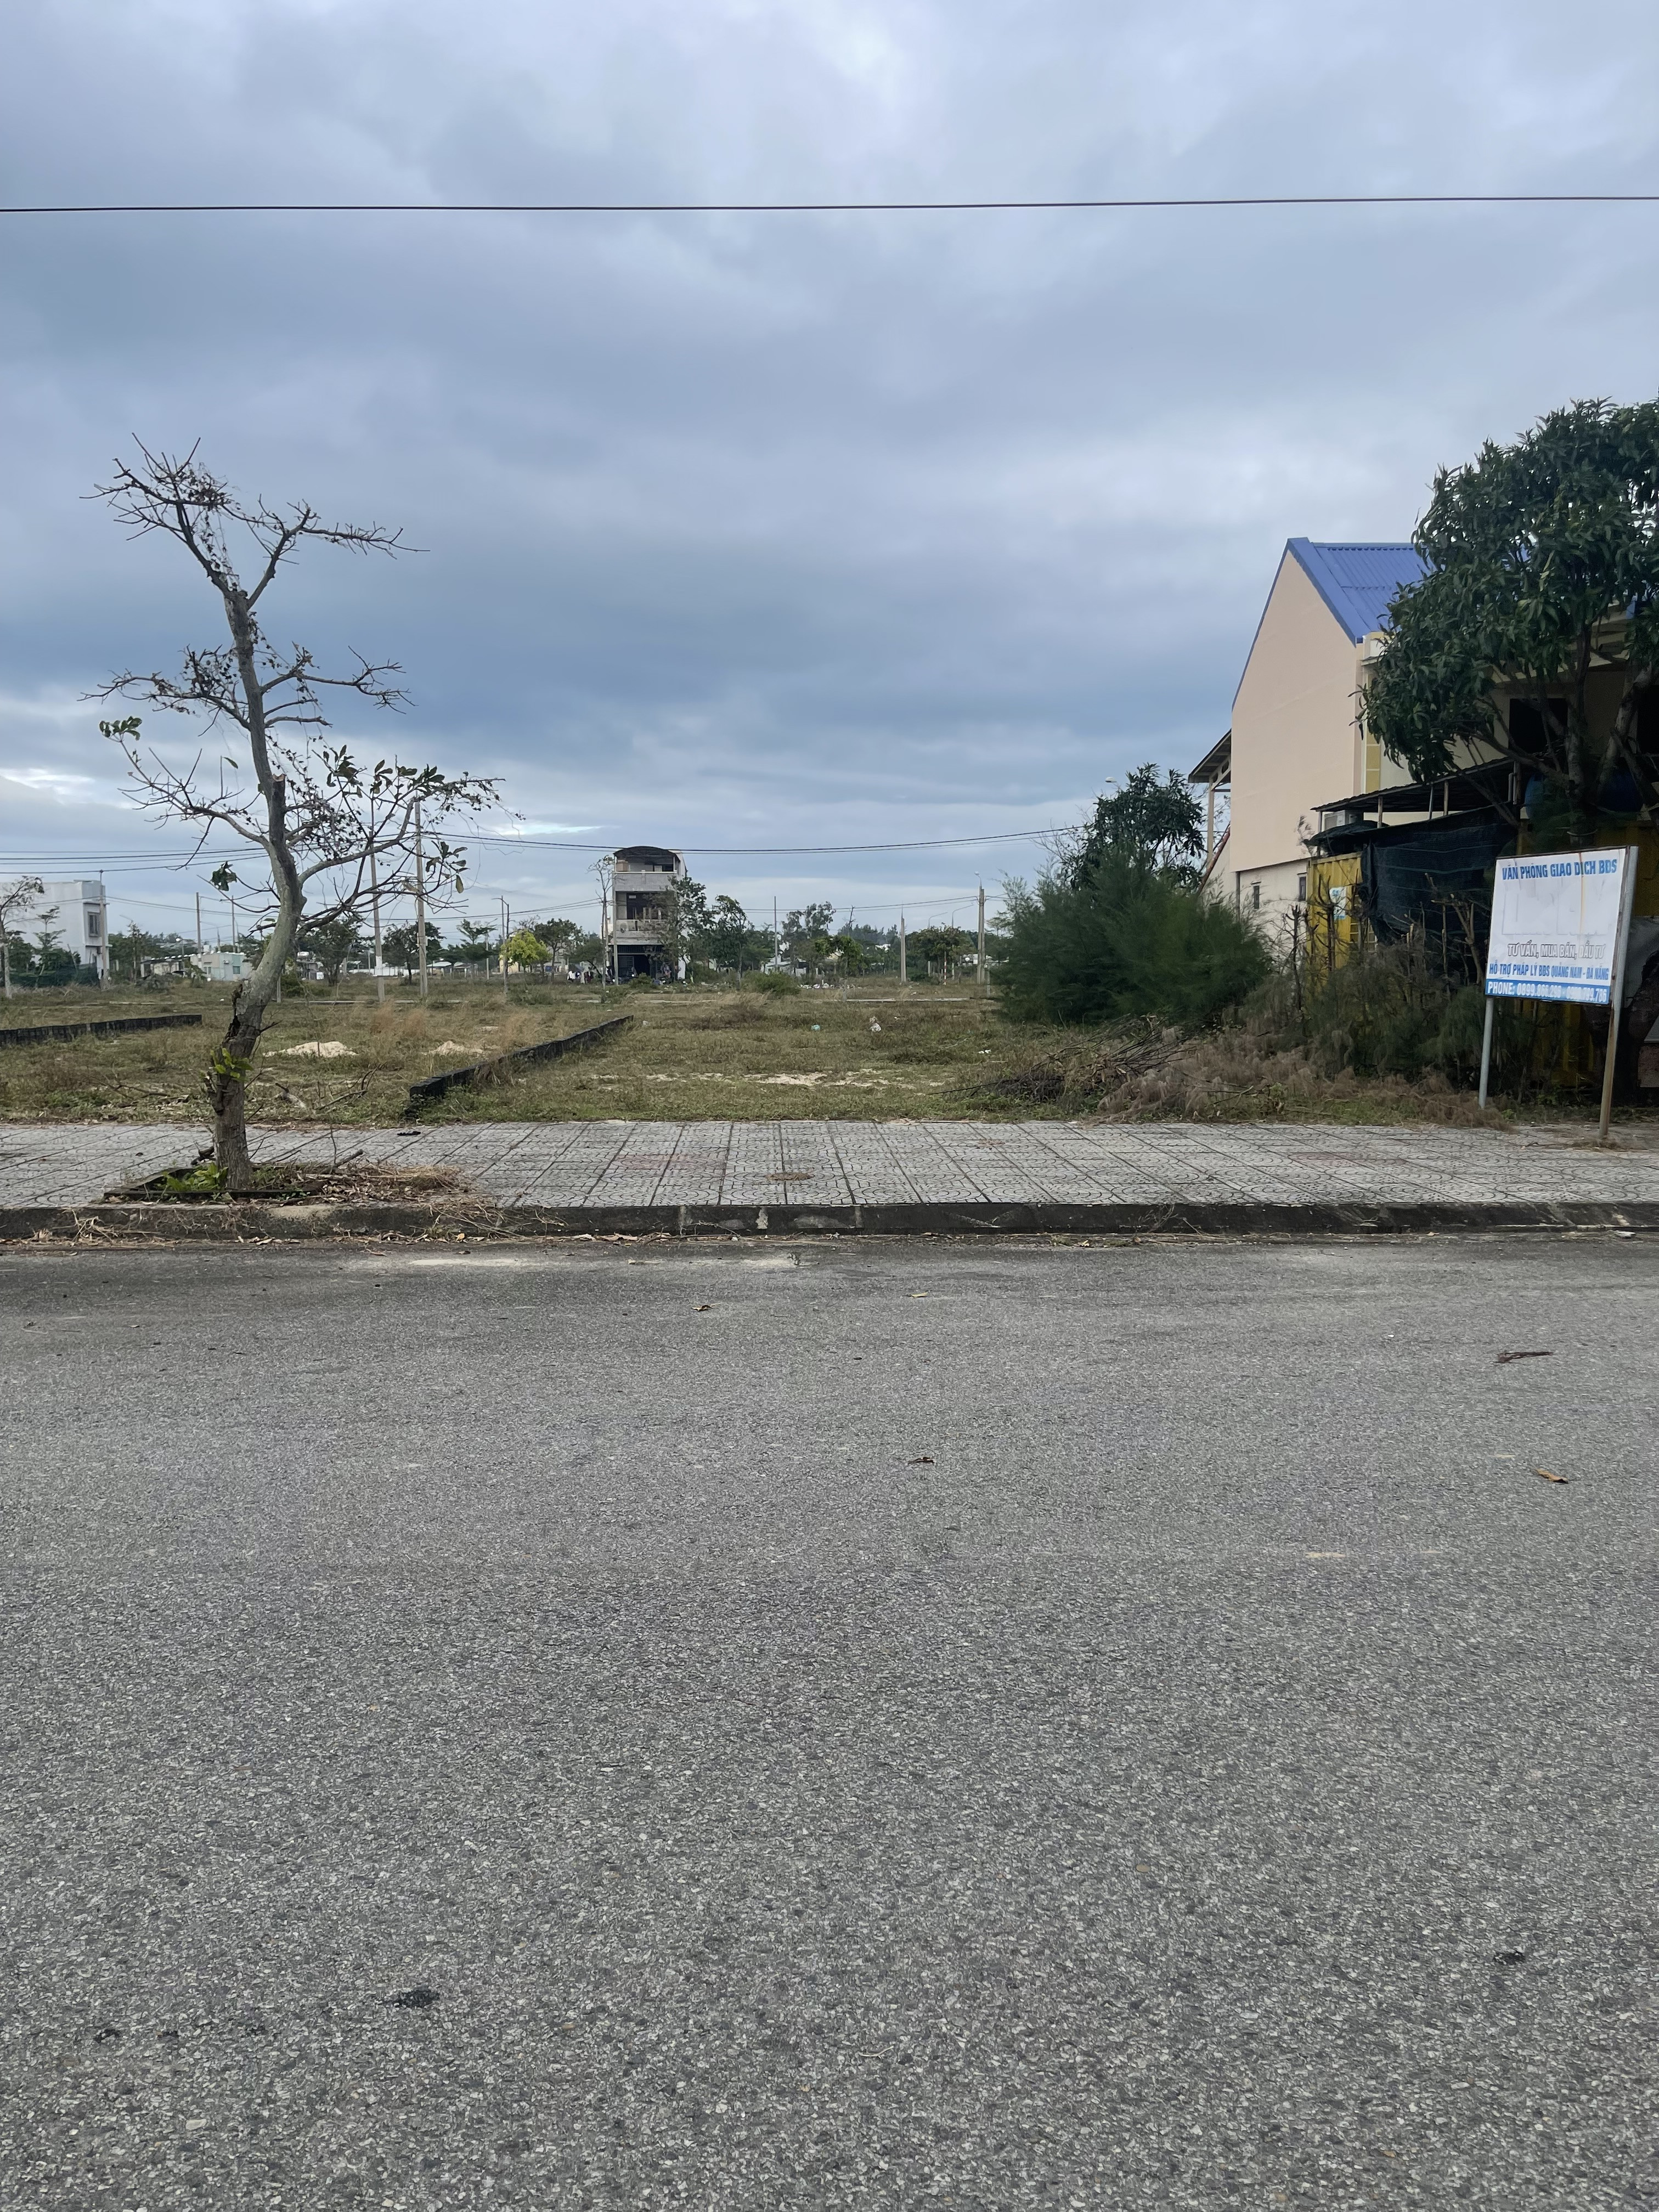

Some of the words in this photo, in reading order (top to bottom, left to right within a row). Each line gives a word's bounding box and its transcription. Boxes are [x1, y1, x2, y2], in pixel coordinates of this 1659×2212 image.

[1550, 862, 1572, 877] GIAO
[1573, 860, 1596, 878] DỊCH
[1540, 944, 1558, 958] MUA
[1500, 963, 1512, 978] TRỢ
[1570, 966, 1582, 979] NAM
[1487, 981, 1515, 995] PHONE:
